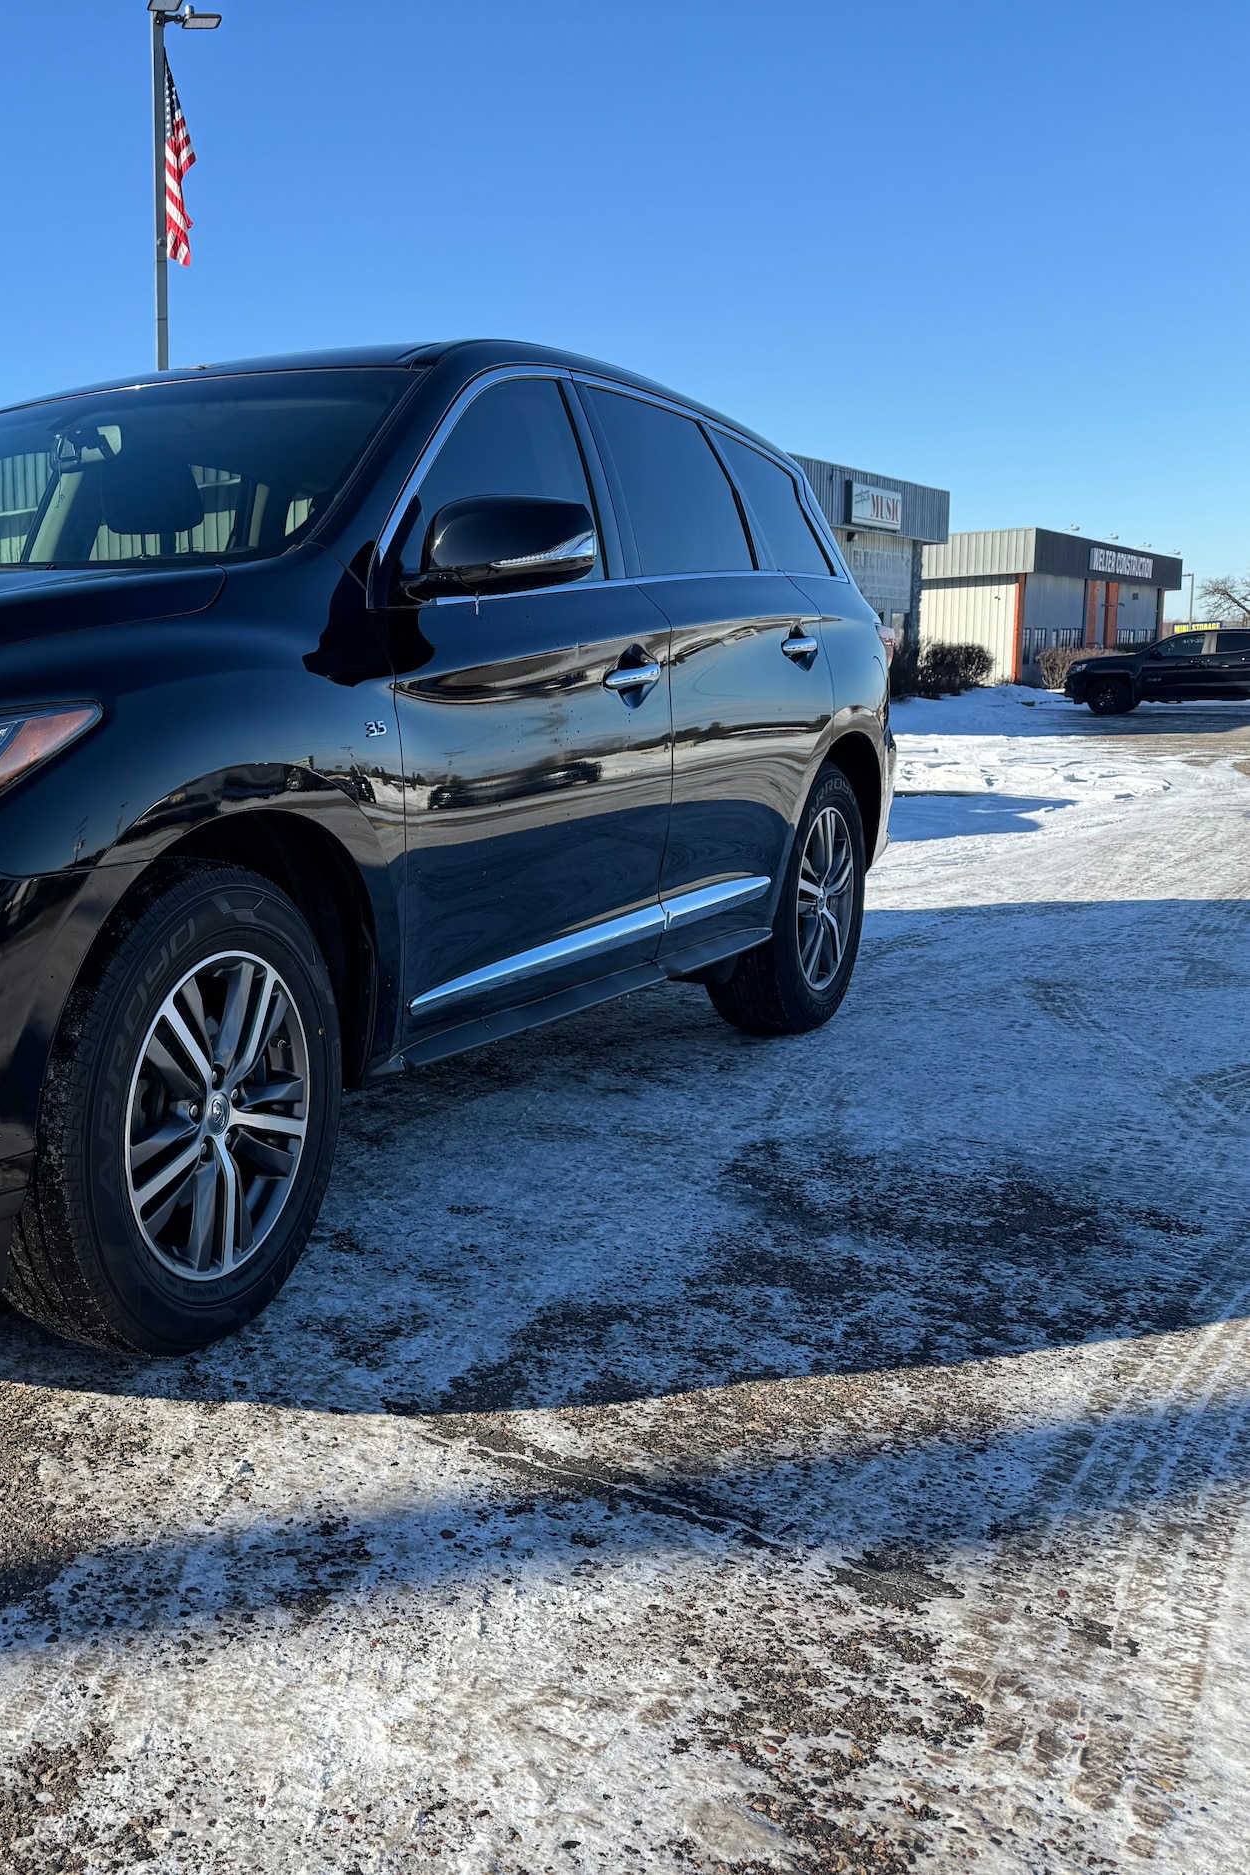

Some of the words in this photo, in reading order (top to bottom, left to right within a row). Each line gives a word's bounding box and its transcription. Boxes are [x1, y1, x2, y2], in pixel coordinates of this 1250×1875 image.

[870, 493, 900, 523] MUSIC
[1116, 551, 1153, 579] CONSTRUCTION
[1192, 622, 1220, 631] STORAGE
